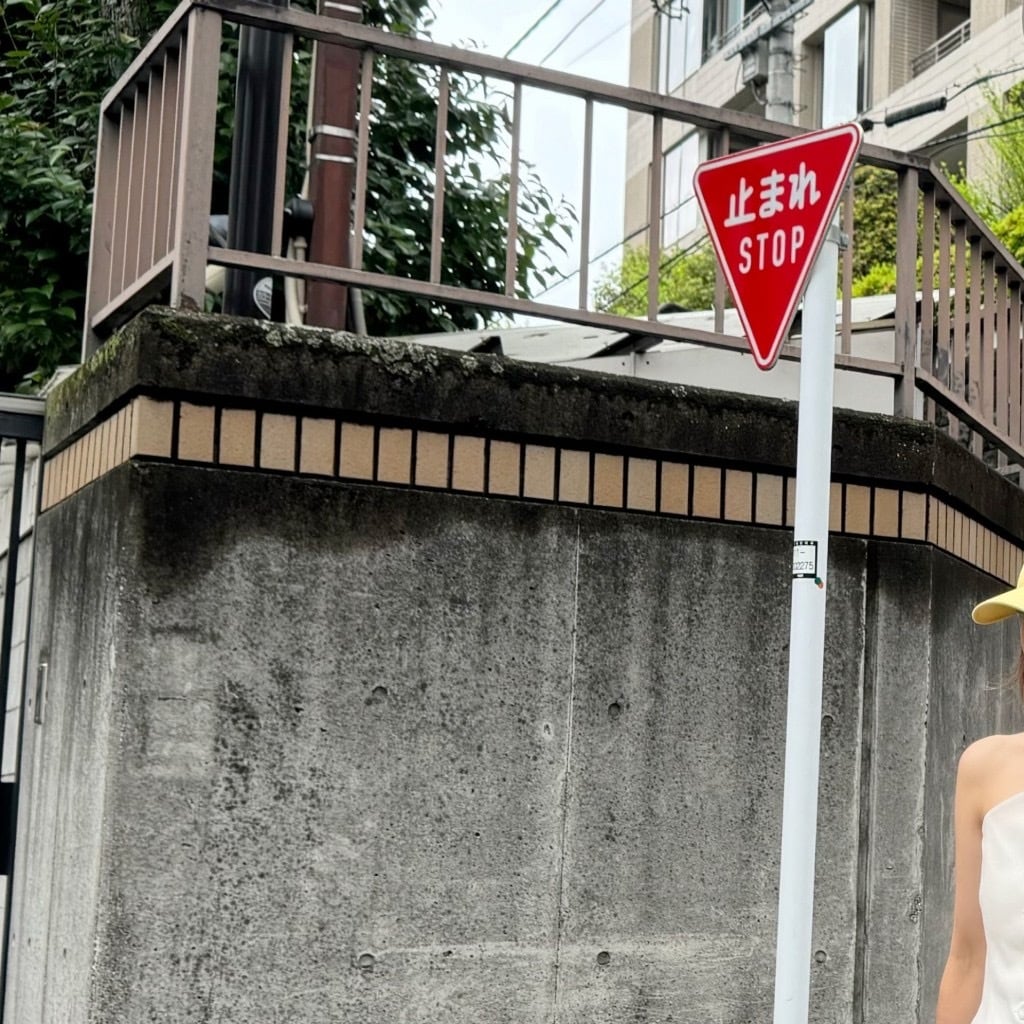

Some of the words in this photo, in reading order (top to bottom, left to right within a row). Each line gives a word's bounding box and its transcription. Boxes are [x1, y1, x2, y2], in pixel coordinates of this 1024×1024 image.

[724, 162, 821, 228] 止まれ
[738, 225, 805, 274] STOP
